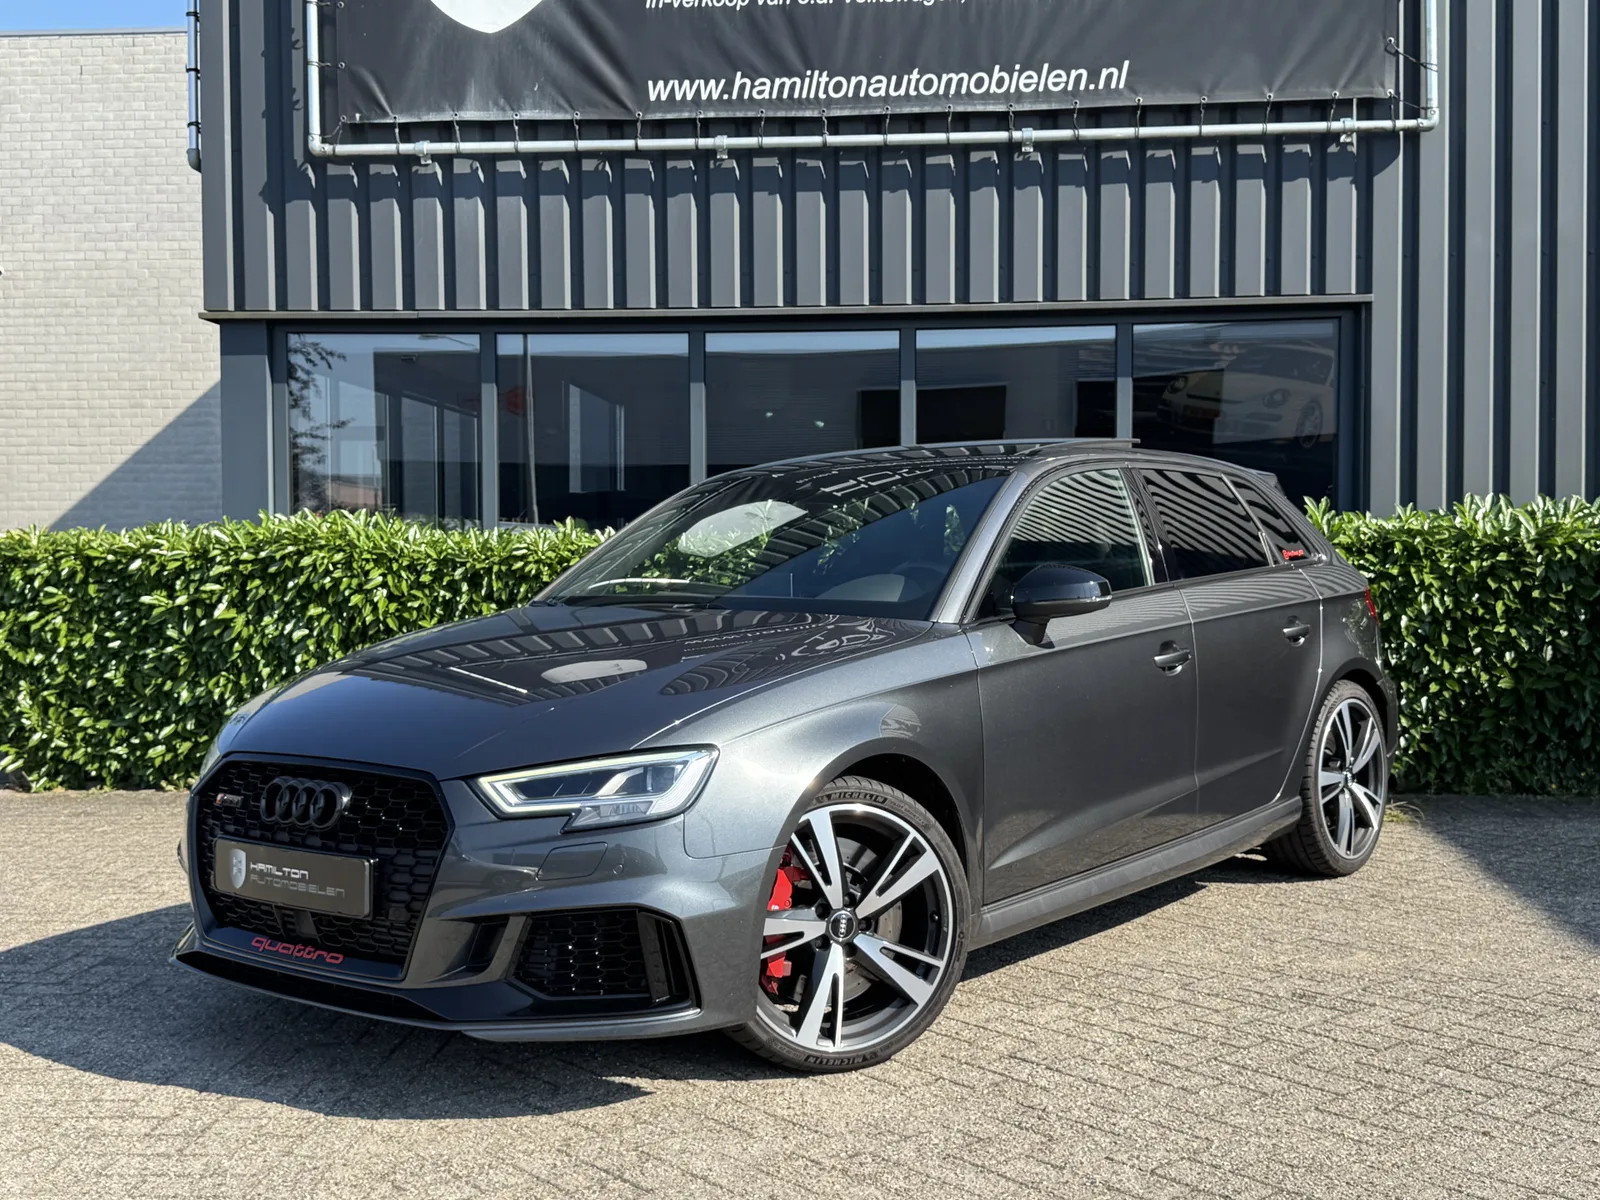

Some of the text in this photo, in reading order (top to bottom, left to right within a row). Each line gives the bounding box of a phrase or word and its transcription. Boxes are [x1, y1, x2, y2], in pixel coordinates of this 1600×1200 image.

[647, 59, 1130, 102] www.hamiltonautomobielen.nl
[829, 791, 886, 804] MICHELIN
[249, 861, 309, 880] HAMILTON
[249, 874, 346, 899] AUTOMOBIELEN
[251, 936, 344, 965] quattro
